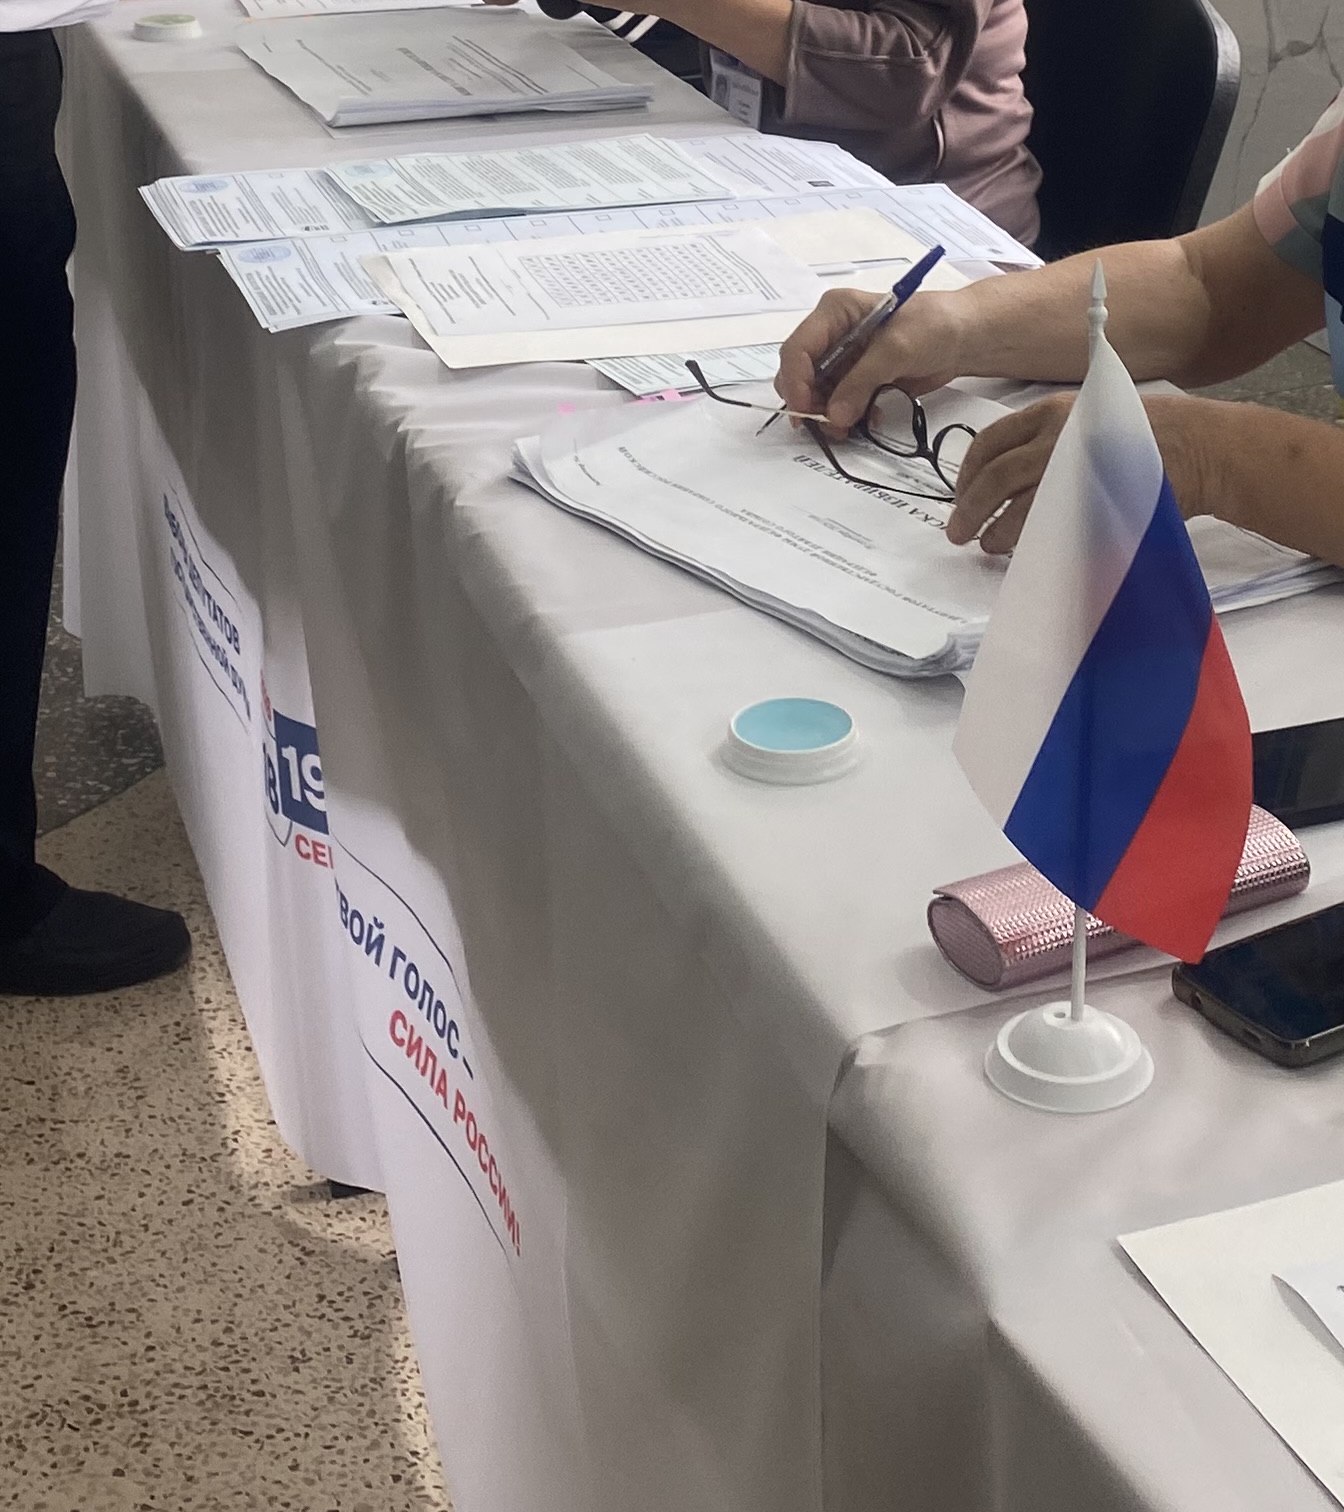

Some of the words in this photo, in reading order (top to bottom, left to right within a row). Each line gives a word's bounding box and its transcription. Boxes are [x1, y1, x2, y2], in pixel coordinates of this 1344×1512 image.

[295, 833, 334, 870] СЕ
[335, 877, 386, 968] ВОЙ
[389, 945, 461, 1059] ГОЛОС
[389, 1009, 449, 1110] СИЛА
[454, 1087, 522, 1257] РОССИИ!
